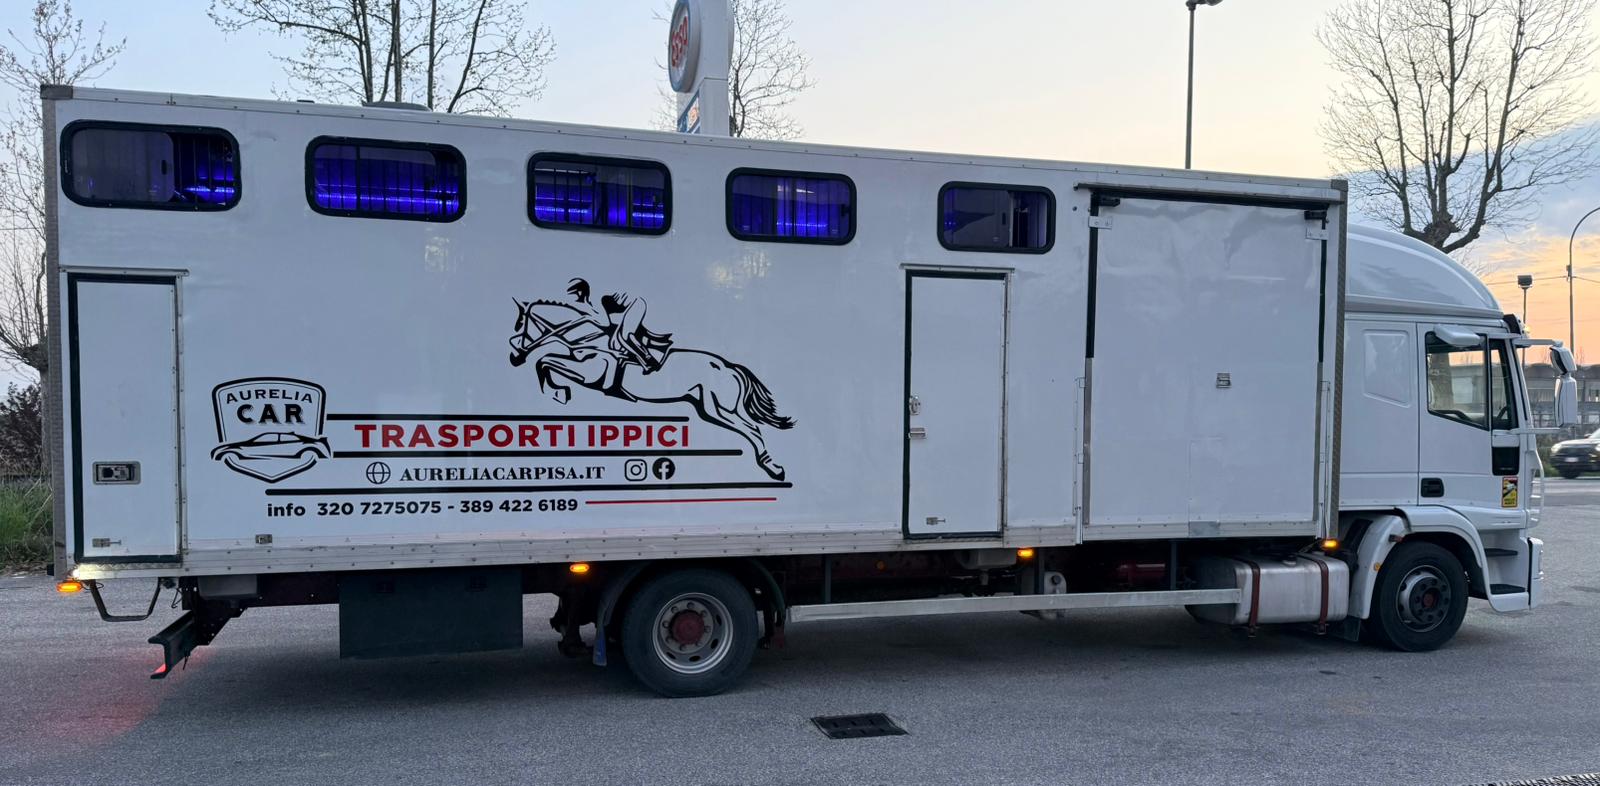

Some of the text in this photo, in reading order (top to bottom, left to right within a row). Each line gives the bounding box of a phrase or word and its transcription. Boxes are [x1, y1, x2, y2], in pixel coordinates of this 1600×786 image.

[226, 388, 314, 404] AURELIA
[236, 403, 305, 425] CAR
[354, 425, 689, 448] TRASPORTI IPPICI
[399, 465, 606, 482] AURELIACARPISA.IT
[267, 501, 306, 518] info
[316, 501, 354, 516] 320
[360, 500, 442, 515] 7275075
[459, 499, 493, 514] 389
[499, 499, 533, 513] 422
[538, 498, 579, 512] 6189
